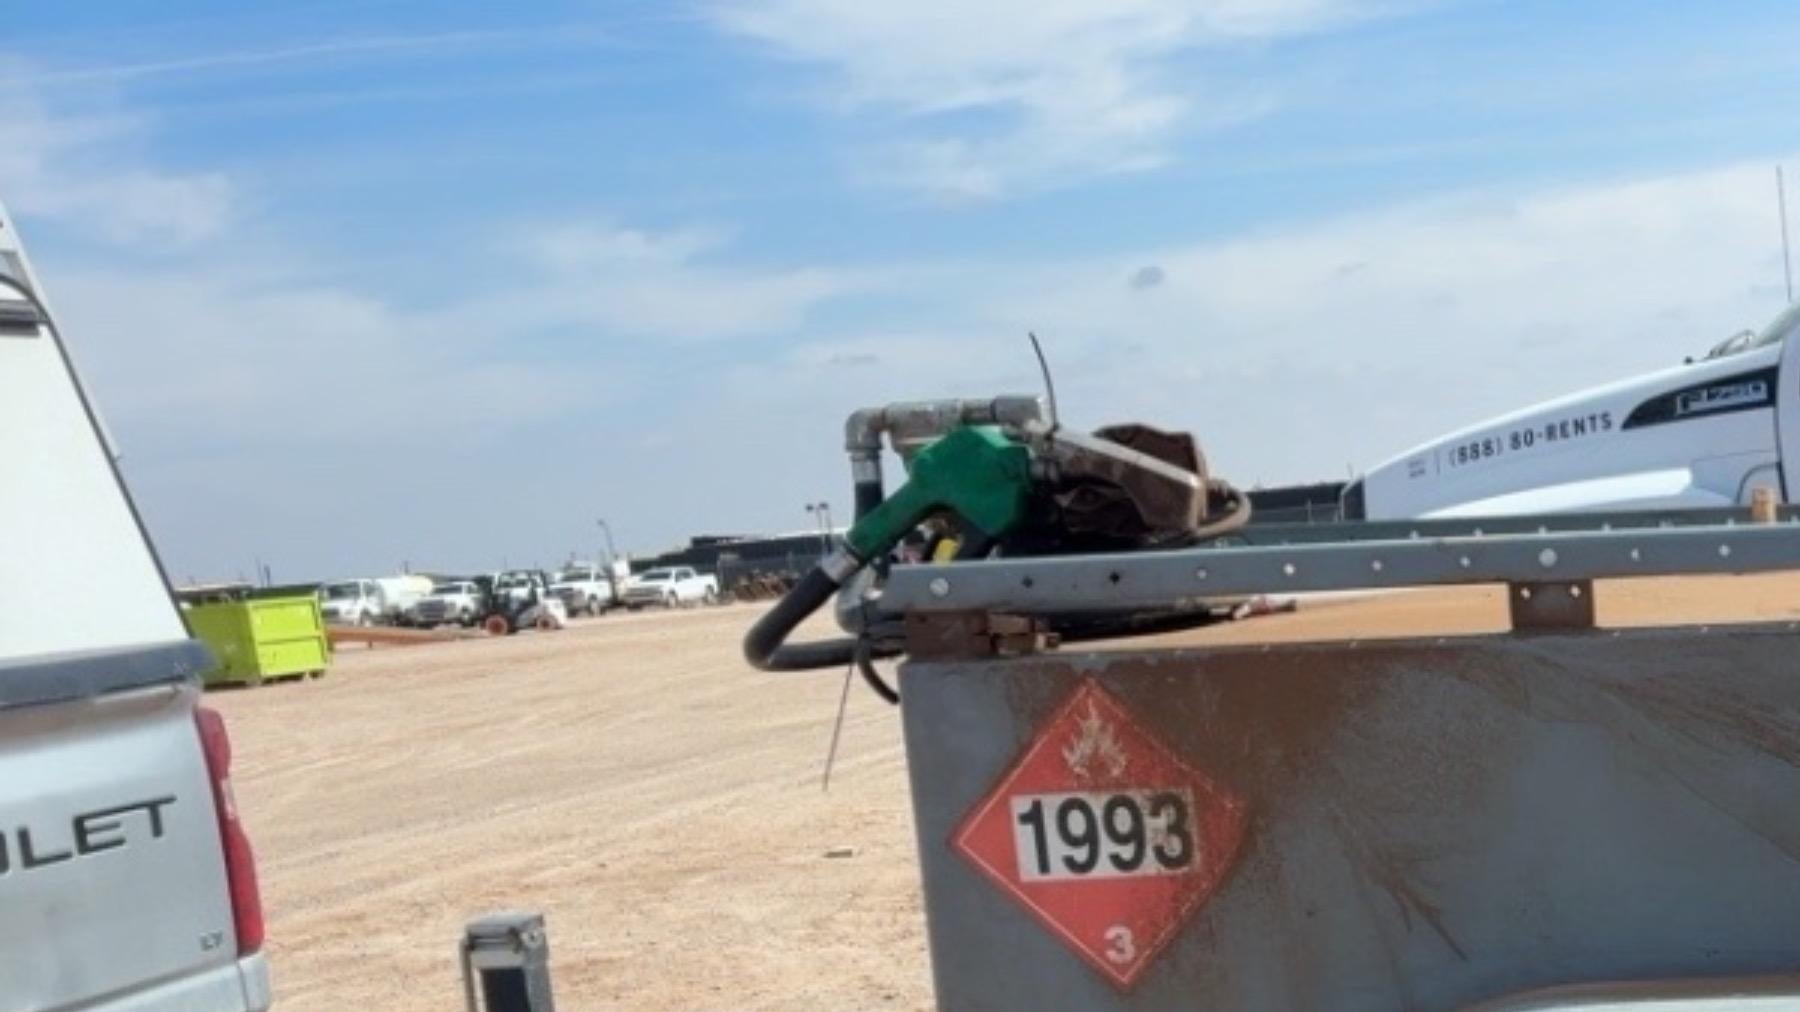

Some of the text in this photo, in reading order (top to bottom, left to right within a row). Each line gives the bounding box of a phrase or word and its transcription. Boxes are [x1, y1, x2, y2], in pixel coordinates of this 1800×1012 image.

[1448, 411, 1612, 467] (888) 80-RENTS
[0, 795, 178, 876] LET
[1017, 792, 1195, 876] 1993
[1103, 925, 1136, 964] 3
